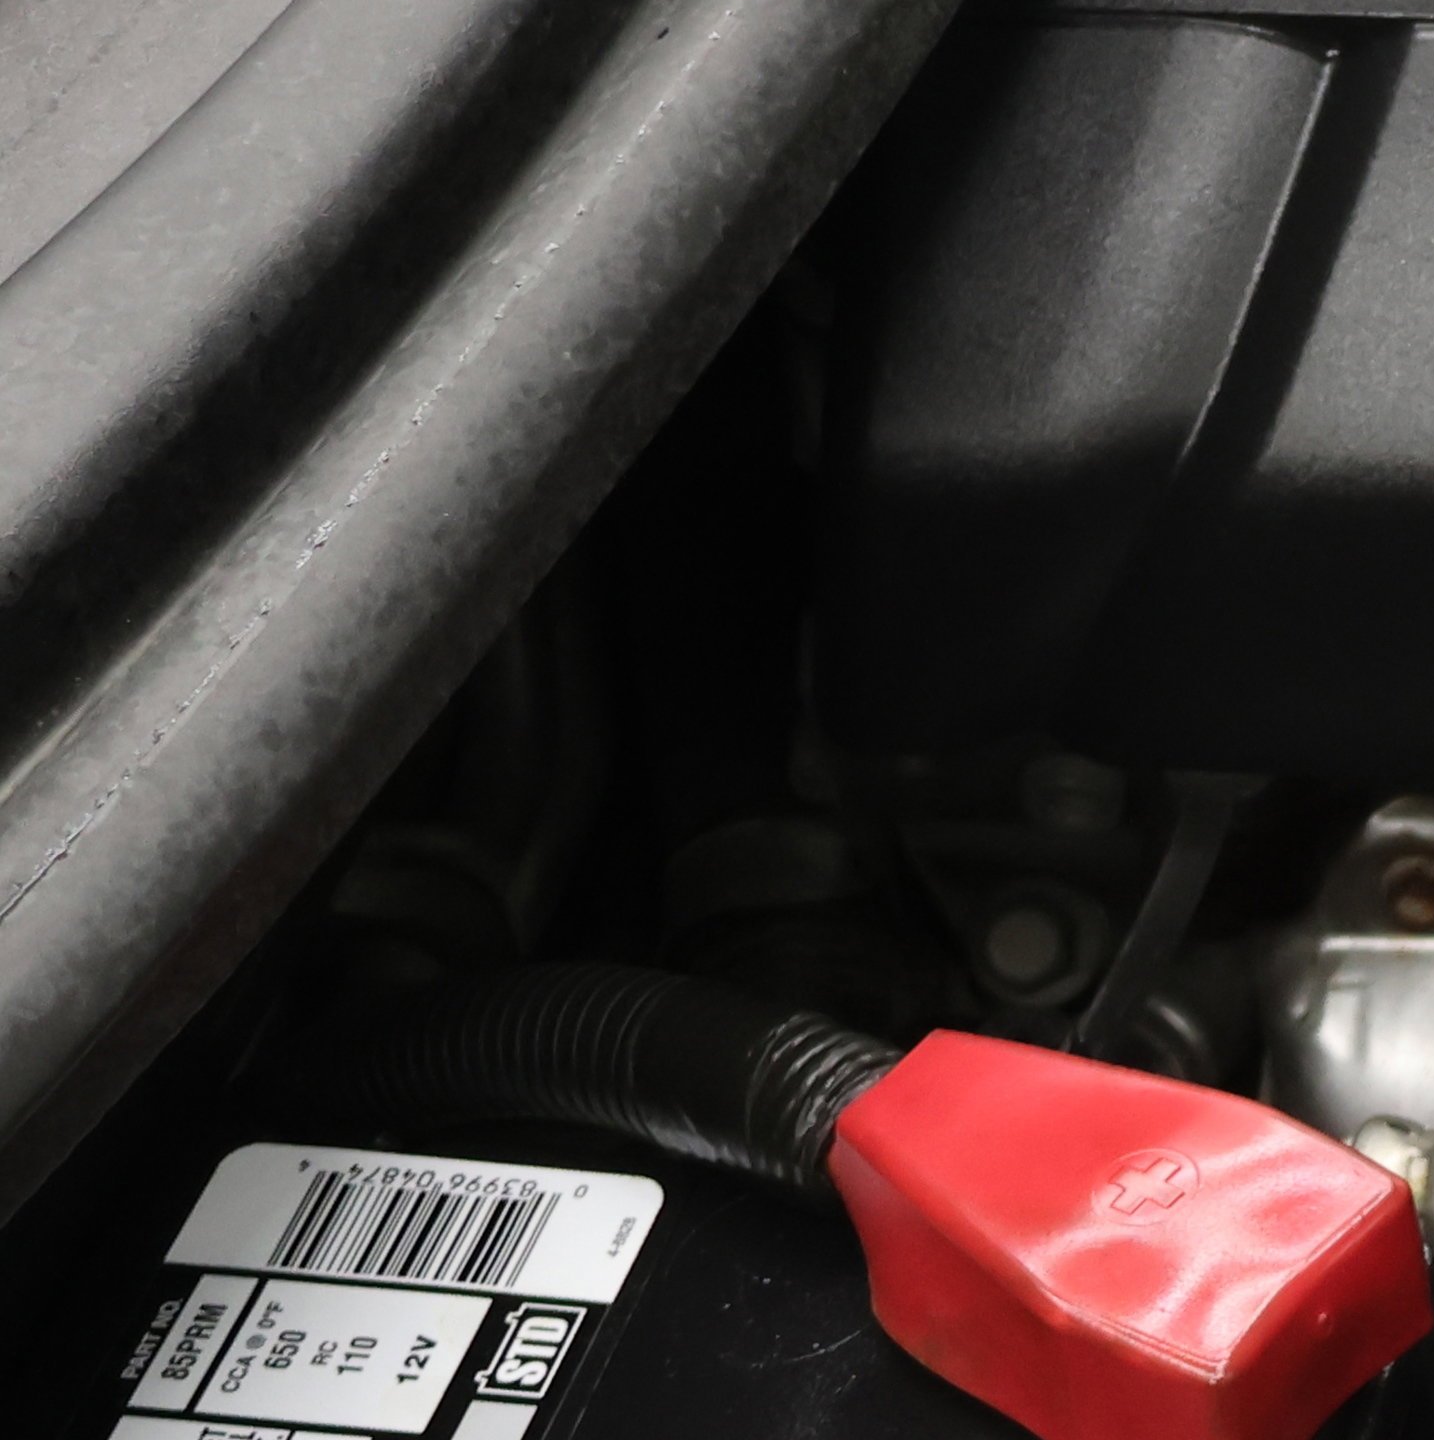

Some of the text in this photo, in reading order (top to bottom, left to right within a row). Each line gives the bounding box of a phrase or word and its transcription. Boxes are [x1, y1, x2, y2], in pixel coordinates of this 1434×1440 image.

[299, 1160, 589, 1197] 0 83996 04874 4
[119, 1296, 184, 1380] PART NO.
[160, 1302, 227, 1380] 85PRM
[262, 1330, 308, 1369] 650
[309, 1340, 340, 1366] RC
[333, 1336, 378, 1377] 110
[490, 1314, 576, 1387] STD
[219, 1355, 257, 1392] CCA
[393, 1334, 440, 1384] 12V
